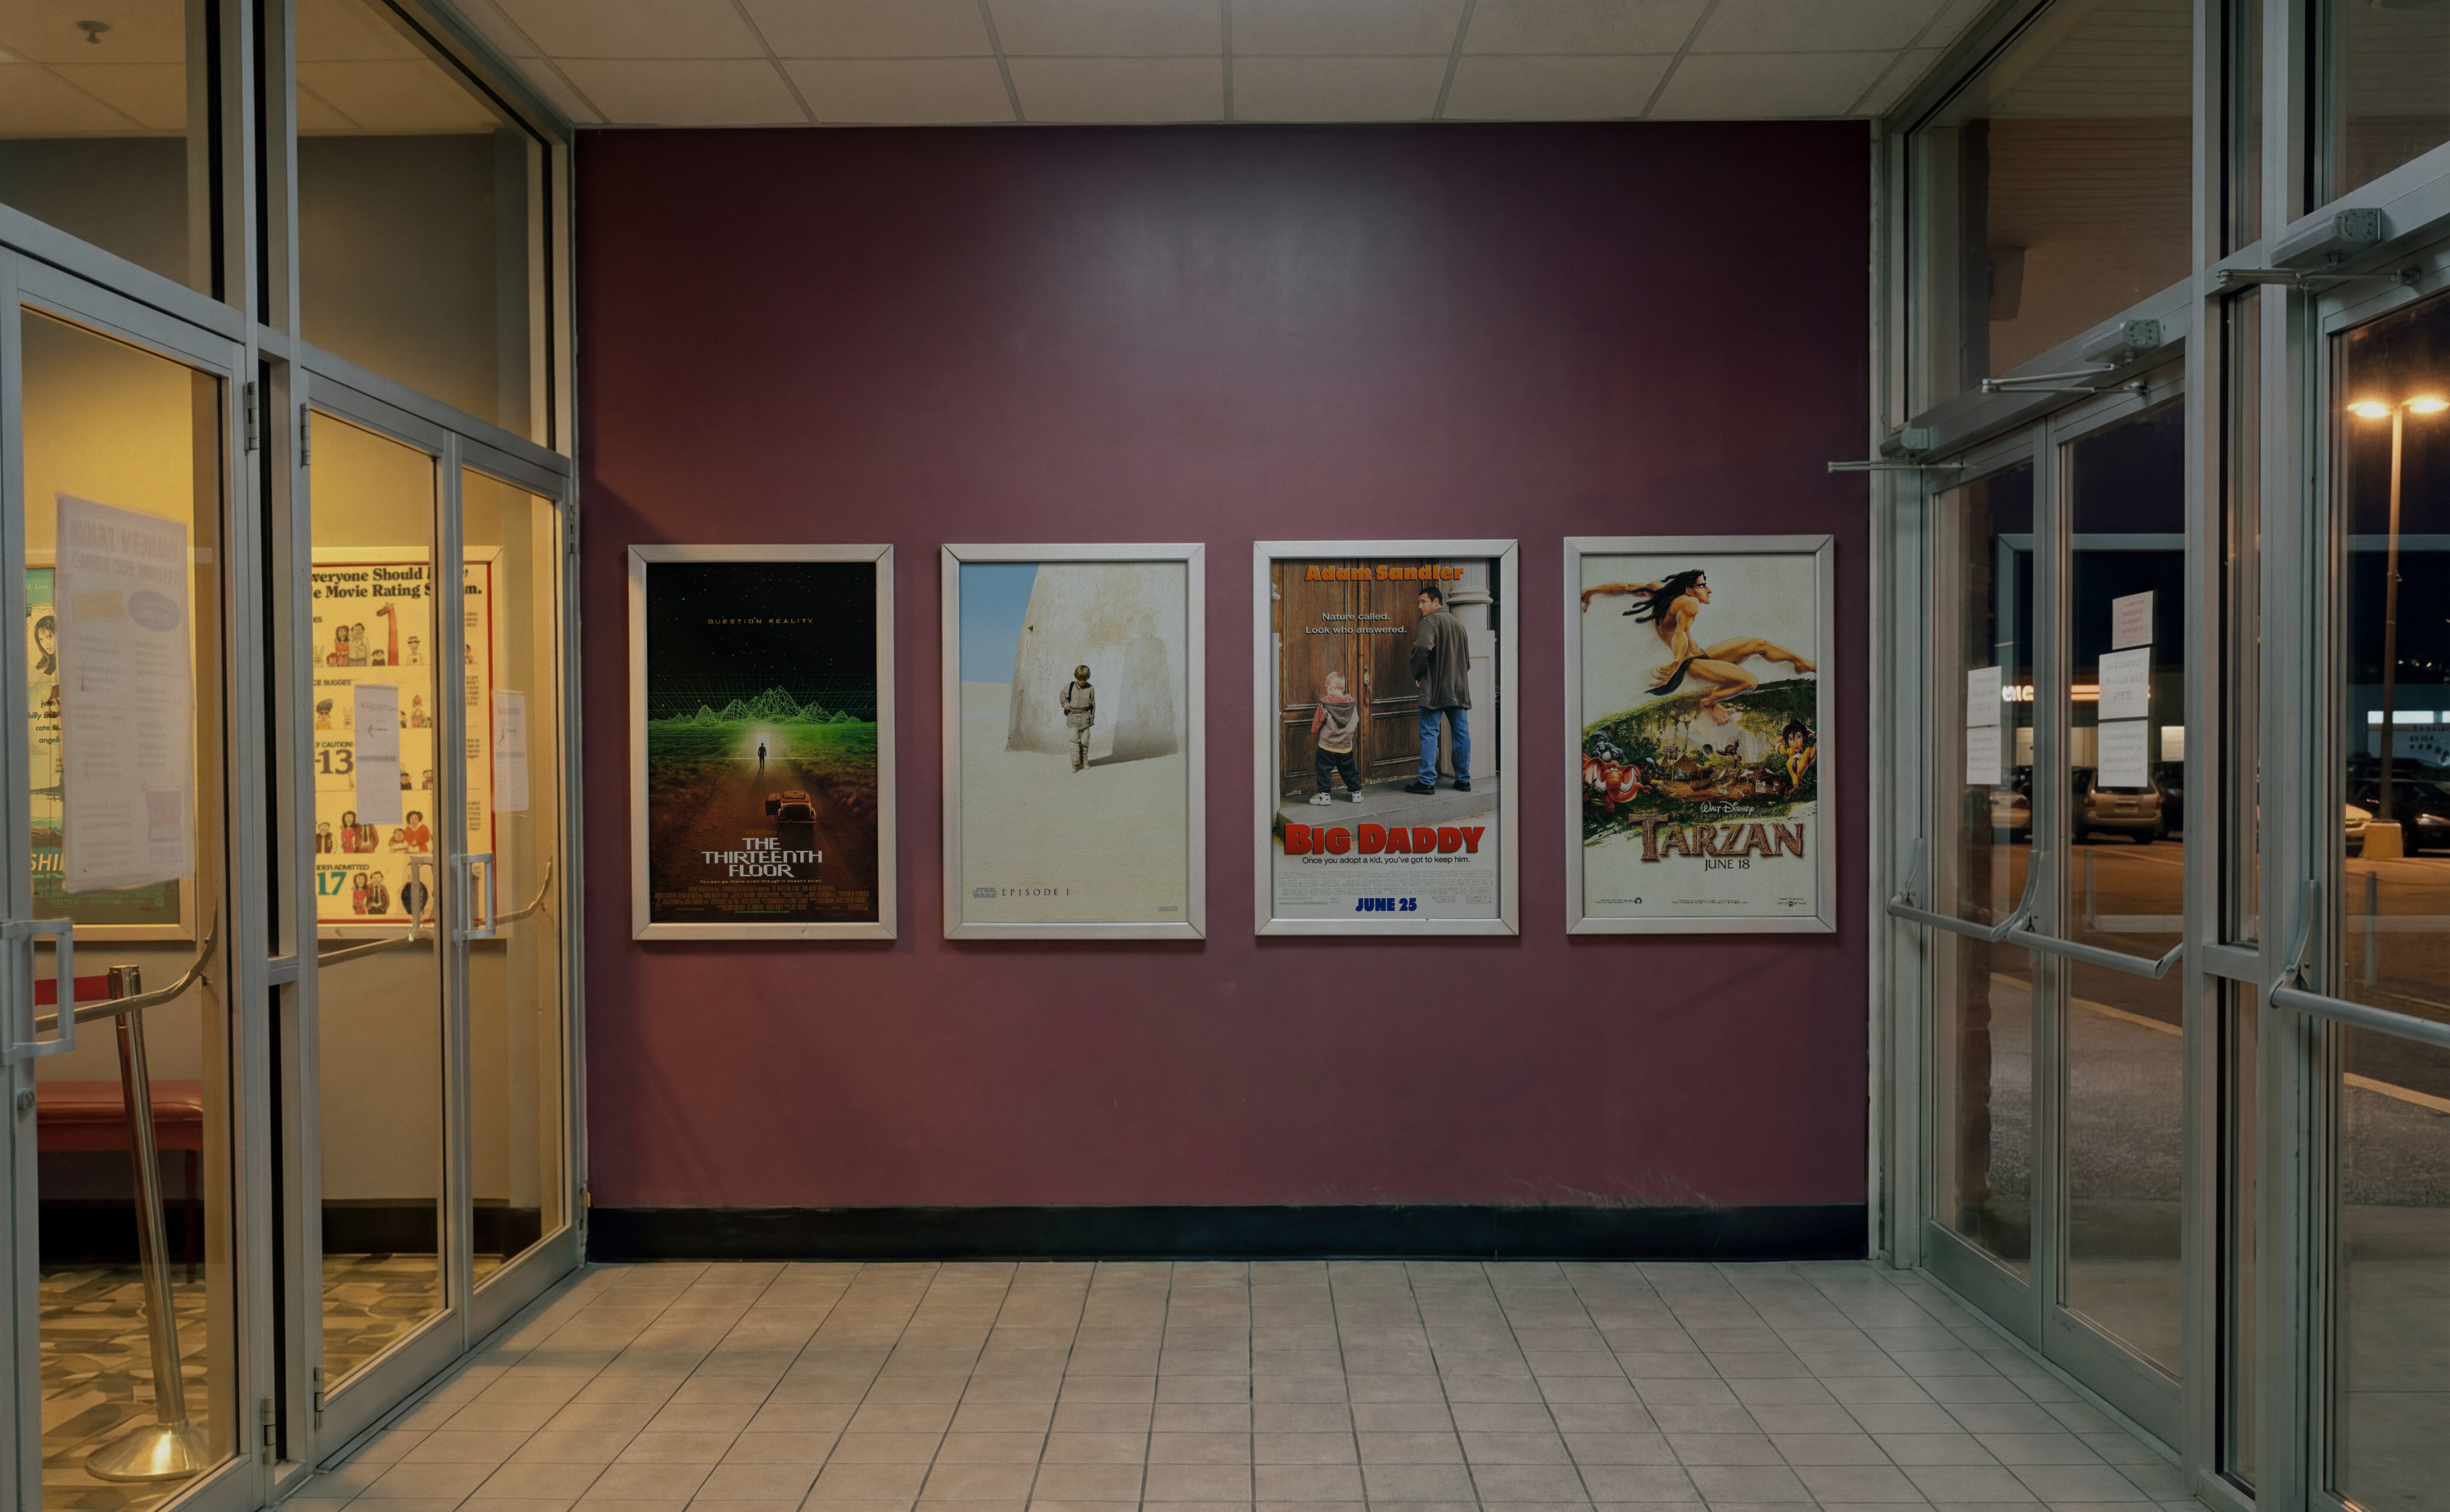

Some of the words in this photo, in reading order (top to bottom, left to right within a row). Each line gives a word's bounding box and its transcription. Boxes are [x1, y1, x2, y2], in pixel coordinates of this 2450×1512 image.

[373, 567, 423, 581] Should
[1305, 565, 1371, 581] Adam
[1376, 565, 1464, 581] Sandler
[325, 584, 368, 598] Movie
[372, 583, 421, 599] Rating
[1322, 613, 1355, 621] Nature
[1358, 613, 1390, 621] called.
[1332, 625, 1353, 634] who
[1356, 625, 1407, 634] answered.
[41, 699, 56, 708] john
[28, 712, 42, 720] billy
[742, 838, 781, 850] THE
[1285, 823, 1351, 854] BIG
[1359, 823, 1486, 854] DADDY
[1629, 813, 1804, 861] TARZAN
[701, 850, 822, 865] THIRTEENTH
[1385, 856, 1409, 865] you've
[728, 864, 794, 878] FLOOR
[1705, 859, 1734, 871] JUNE
[1738, 859, 1750, 869] 18
[1355, 897, 1396, 912] JUNE
[1399, 897, 1417, 912] 25
